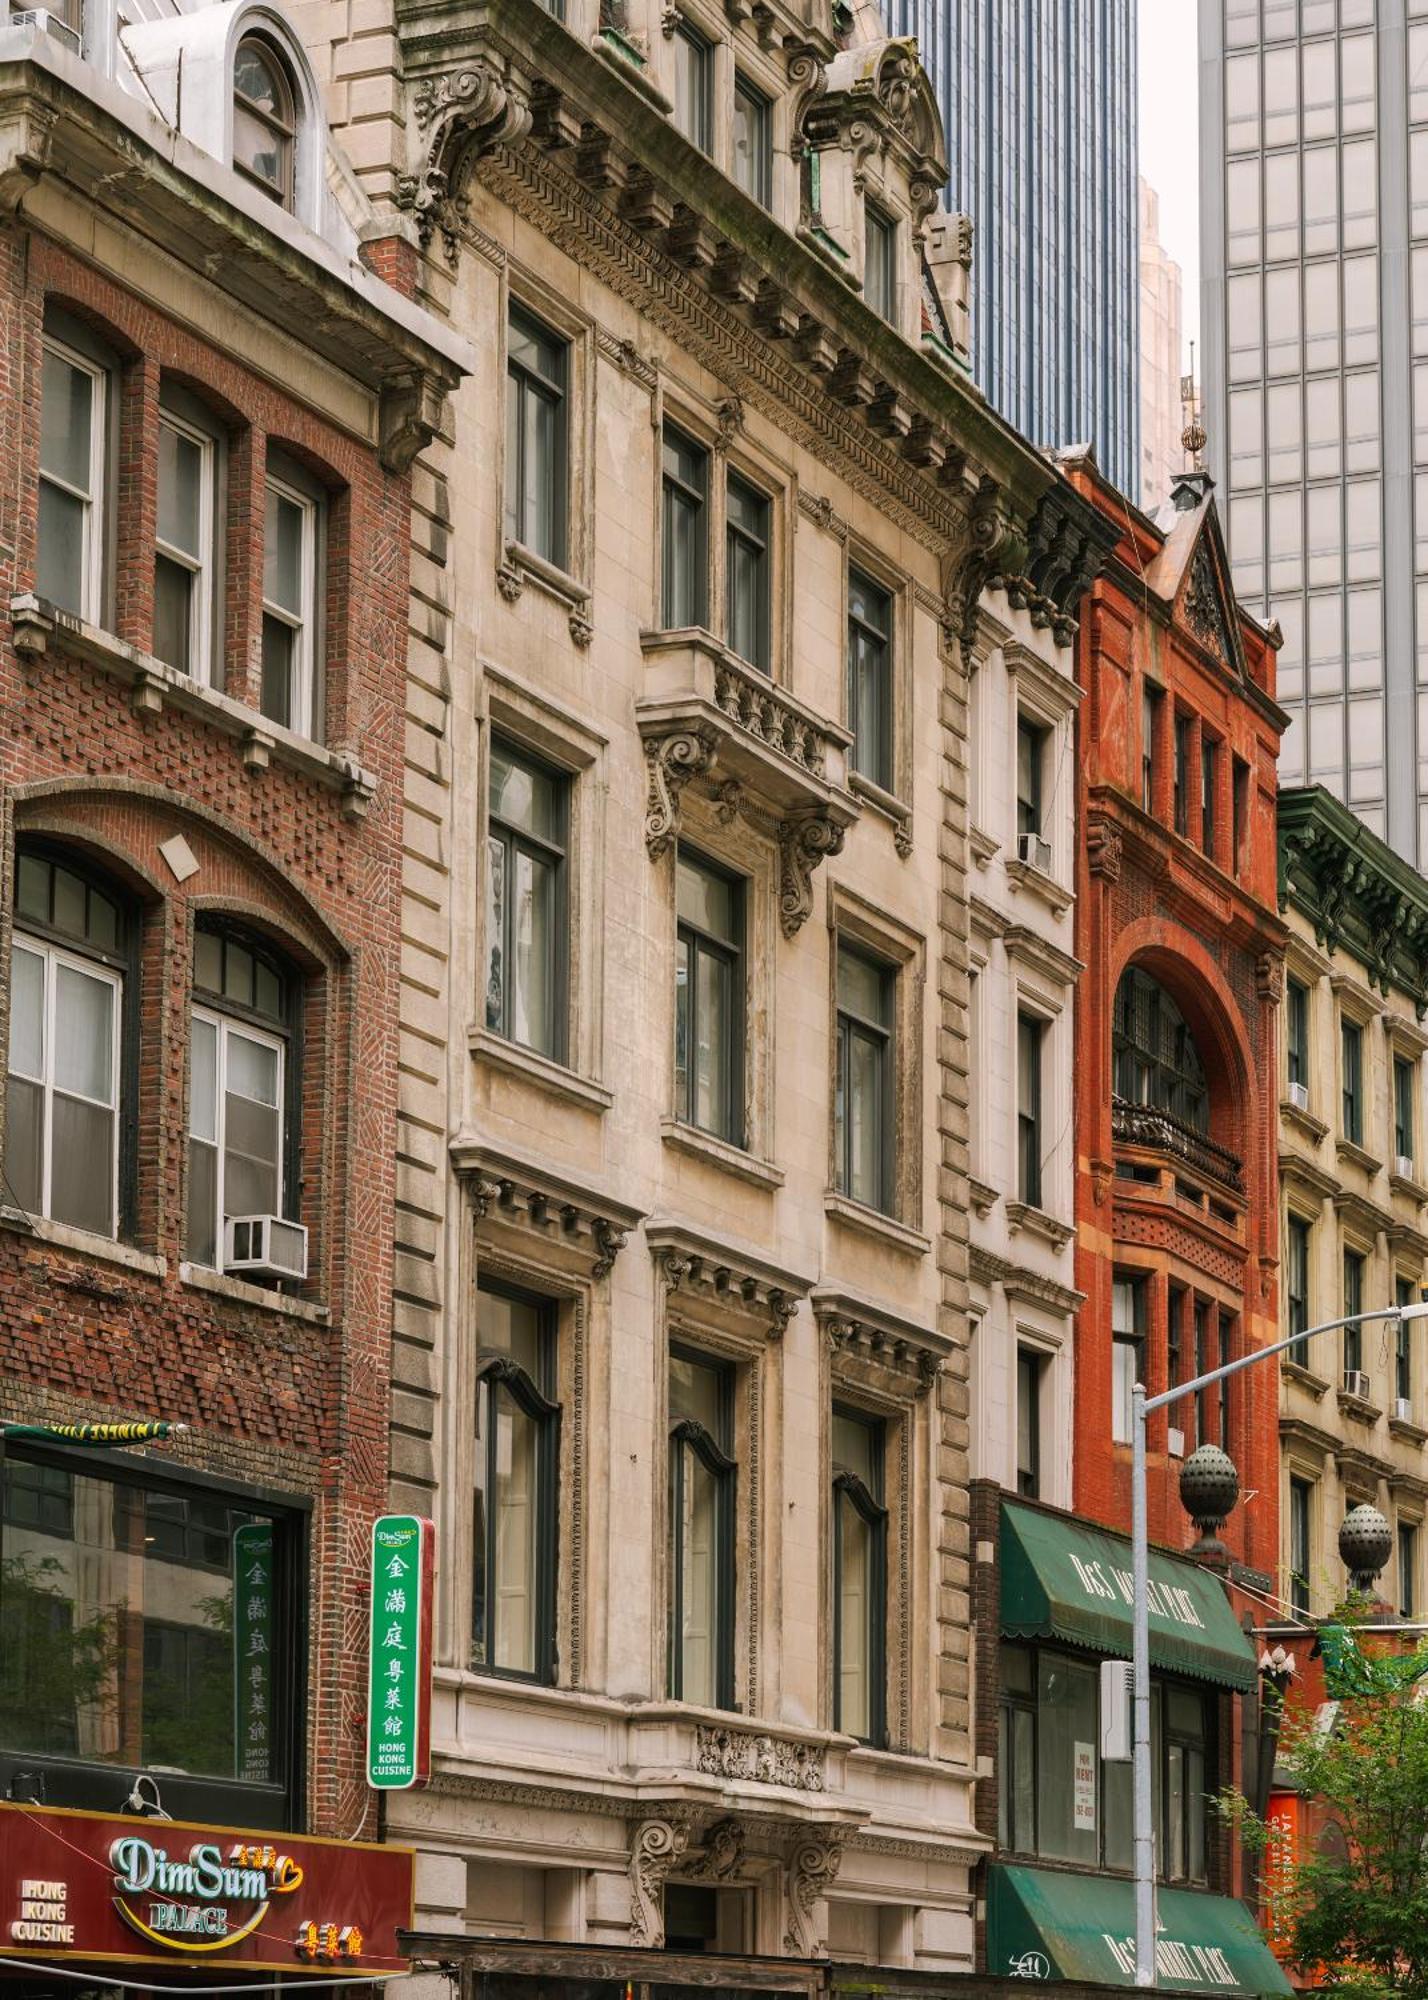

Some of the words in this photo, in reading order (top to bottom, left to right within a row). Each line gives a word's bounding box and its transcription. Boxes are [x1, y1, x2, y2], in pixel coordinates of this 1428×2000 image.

[379, 1743, 406, 1753] HONG
[379, 1754, 405, 1764] KONG
[372, 1766, 411, 1776] CUISINE
[1076, 1767, 1093, 1782] RENT
[22, 1880, 67, 1900] HONG
[22, 1901, 66, 1921] KONG
[150, 1903, 228, 1934] PALACE
[12, 1921, 75, 1943] CUISINE
